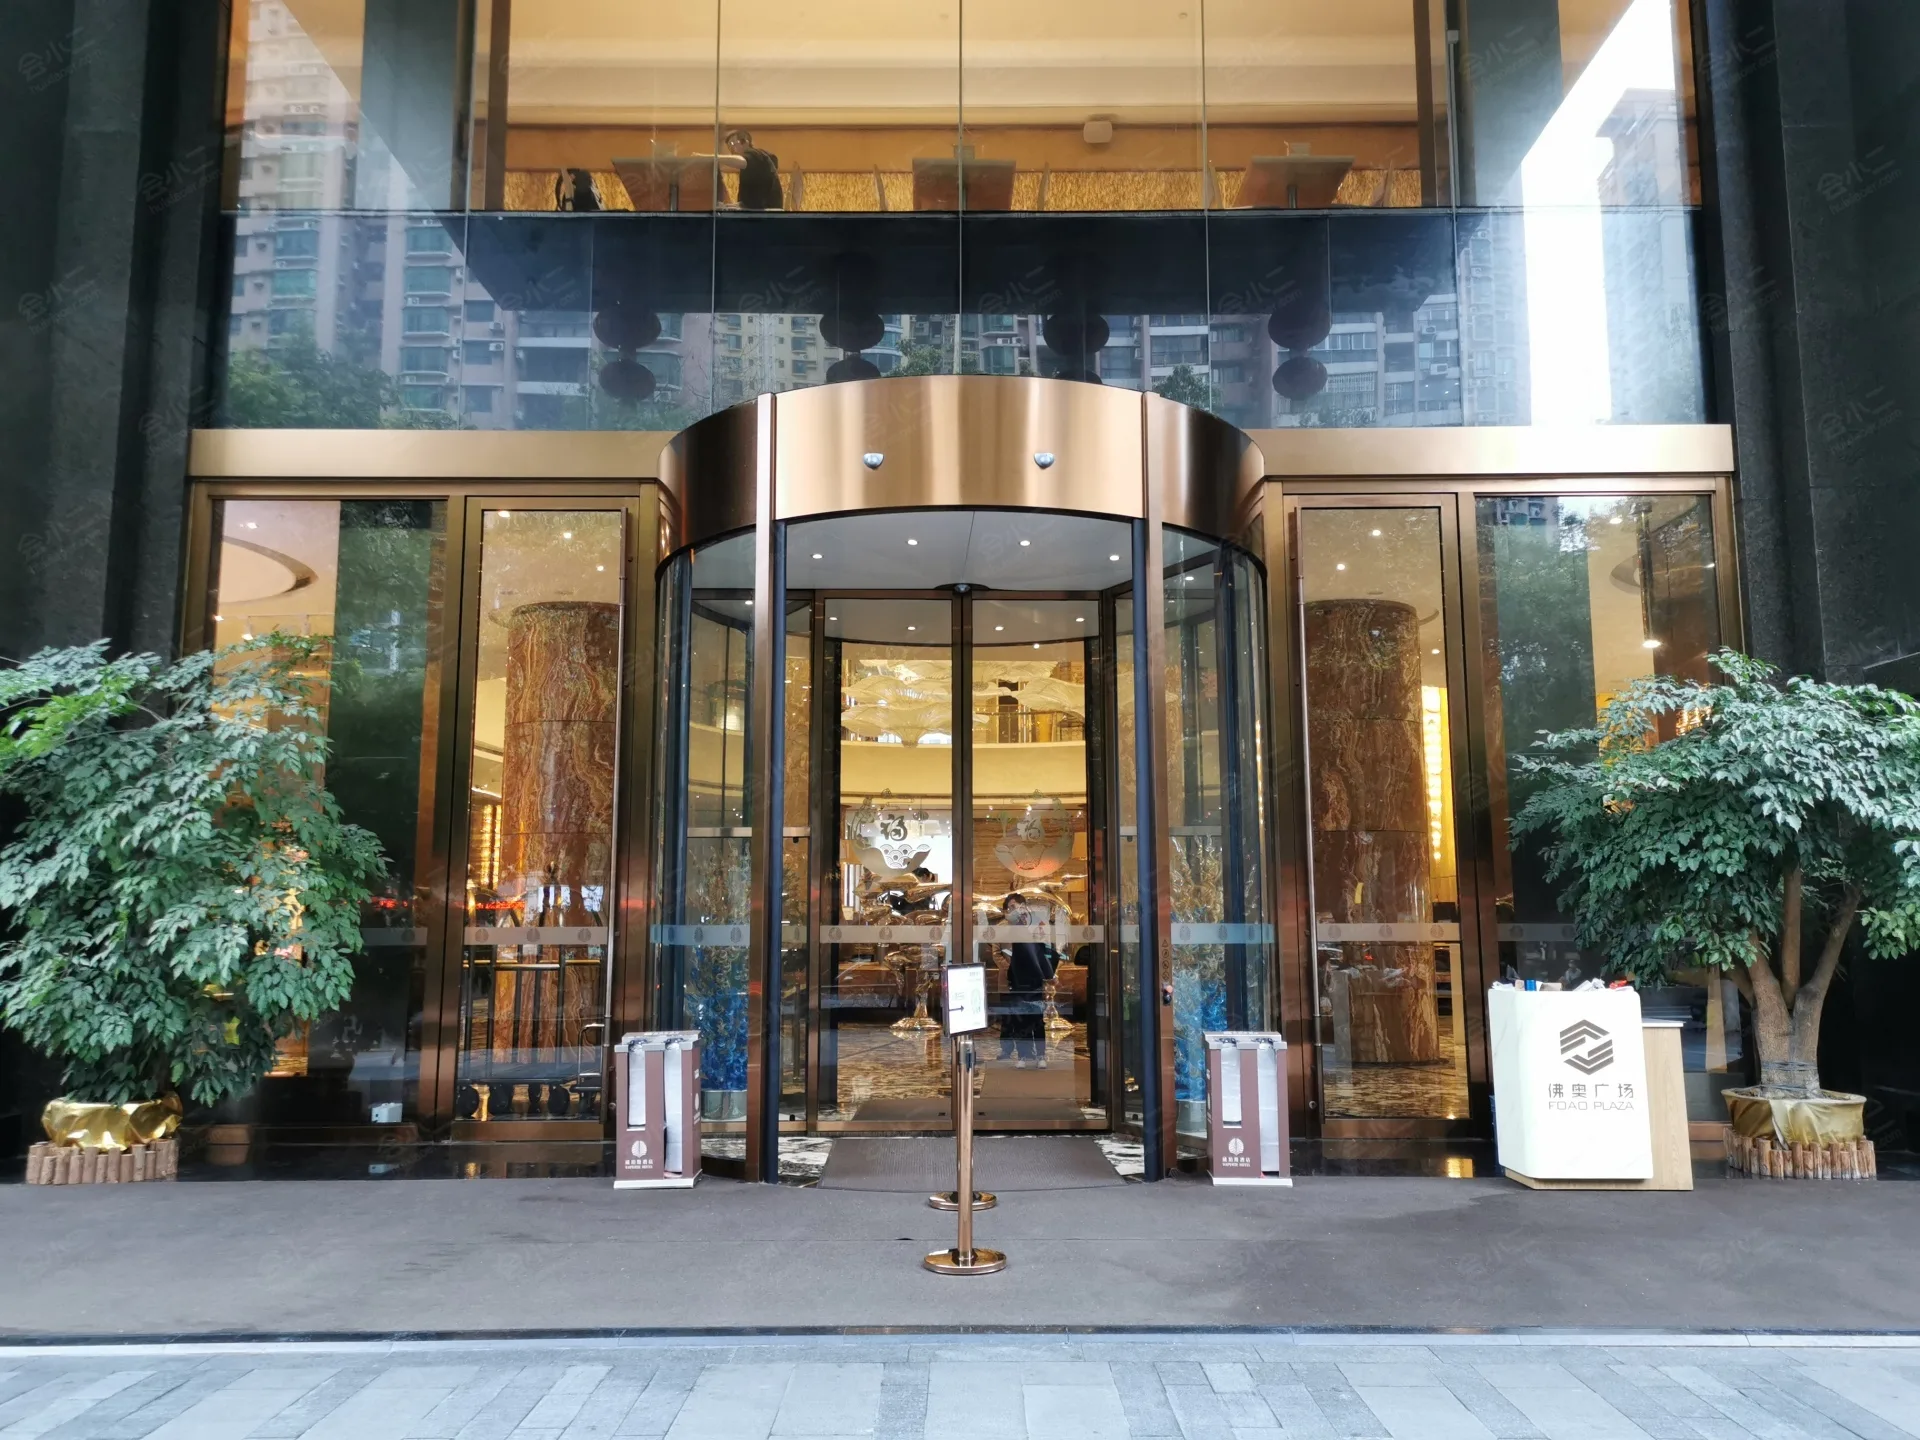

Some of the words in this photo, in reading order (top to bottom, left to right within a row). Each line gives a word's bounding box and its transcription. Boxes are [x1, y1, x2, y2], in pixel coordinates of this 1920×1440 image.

[1548, 1083, 1634, 1098] 佛奥广场
[1549, 1101, 1588, 1110] FOAO
[1593, 1101, 1634, 1111] PLAZA
